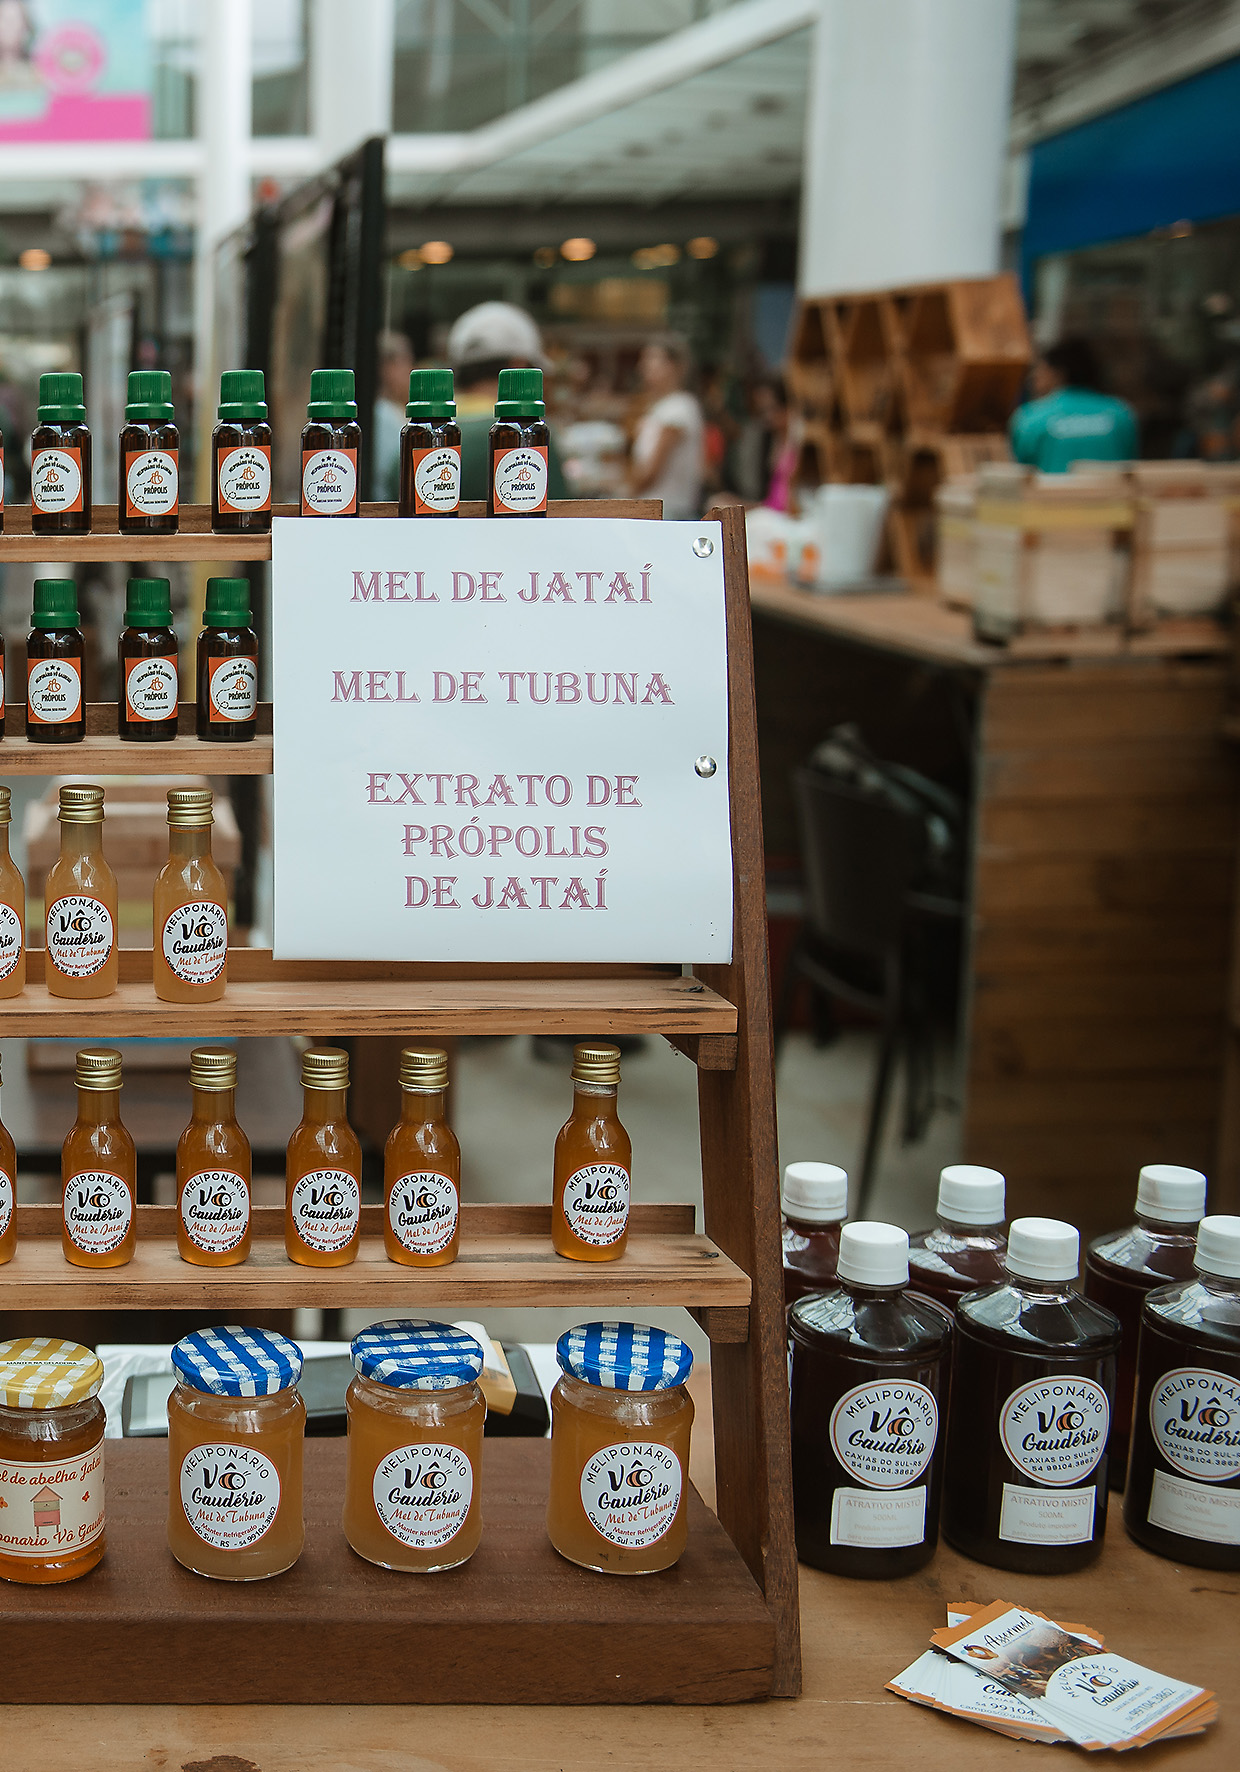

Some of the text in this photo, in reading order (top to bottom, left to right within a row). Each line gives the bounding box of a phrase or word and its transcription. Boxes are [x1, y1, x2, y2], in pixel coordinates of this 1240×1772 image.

[42, 483, 64, 492] PRÓPOLIS
[144, 485, 167, 494] PRÓPOLIS
[236, 481, 260, 490] PRÓPOLIS
[317, 484, 341, 493] PRÓPOLIS
[434, 482, 455, 491] PRÓPOLIS
[511, 482, 535, 491] PRÓPOLIS
[350, 563, 654, 604] MEL DE JATAÍ
[144, 692, 167, 700] PRÓPOLIS
[229, 691, 251, 700] PRÓPOLIS
[330, 670, 675, 705] MEL DE TUBUNA
[42, 693, 66, 701] PRÓPOLIS
[365, 772, 643, 809] EXTRATO DE
[400, 816, 610, 860] PRÓPOLIS
[403, 869, 609, 910] DE JATAÍ
[49, 898, 108, 926] MELIPONÁRIO
[166, 903, 225, 935] MELIPONÁRIO
[66, 1173, 126, 1200] MELIPONÁRIO
[185, 1172, 246, 1198] MELIPONÁRIO
[296, 1172, 357, 1198] MELIPONÁRIO
[569, 1166, 629, 1191] MELIPONÁRIO
[391, 1174, 452, 1206] MELIPONÁRIO
[846, 1390, 933, 1427] MELIPONÁRIO
[1011, 1385, 1103, 1424] MELIPONÁRIO
[848, 1429, 926, 1455] Gaudério
[1022, 1427, 1101, 1451] Gaudério
[1163, 1440, 1210, 1456] CAXIAS DO
[1170, 1450, 1181, 1458] 54
[185, 1447, 269, 1478] MELIPONÁRIO
[382, 1447, 467, 1478] MELIPONÁRIO
[586, 1445, 673, 1484] MELIPONÁRIO
[845, 1451, 877, 1464] CAXIAS
[880, 1458, 892, 1466] DO
[1022, 1456, 1056, 1464] CAXIAS
[10, 1472, 27, 1485] de
[29, 1470, 78, 1485] abelha
[192, 1487, 266, 1507] Gaudério
[388, 1487, 462, 1506] Gaudério
[598, 1483, 671, 1509] Gaudério
[846, 1499, 921, 1509] ATRATIVO MISTO
[1011, 1495, 1088, 1508] ATRATIVO MISTO
[195, 1509, 265, 1523] Mel de Tubuna
[390, 1509, 460, 1521] Mel de Tubuna
[604, 1500, 673, 1527] Mel de Tubuna
[53, 1529, 75, 1543] Vô
[201, 1523, 221, 1537] Manter
[397, 1522, 418, 1535] Manter
[613, 1527, 636, 1536] Manter
[203, 1533, 214, 1543] Sul
